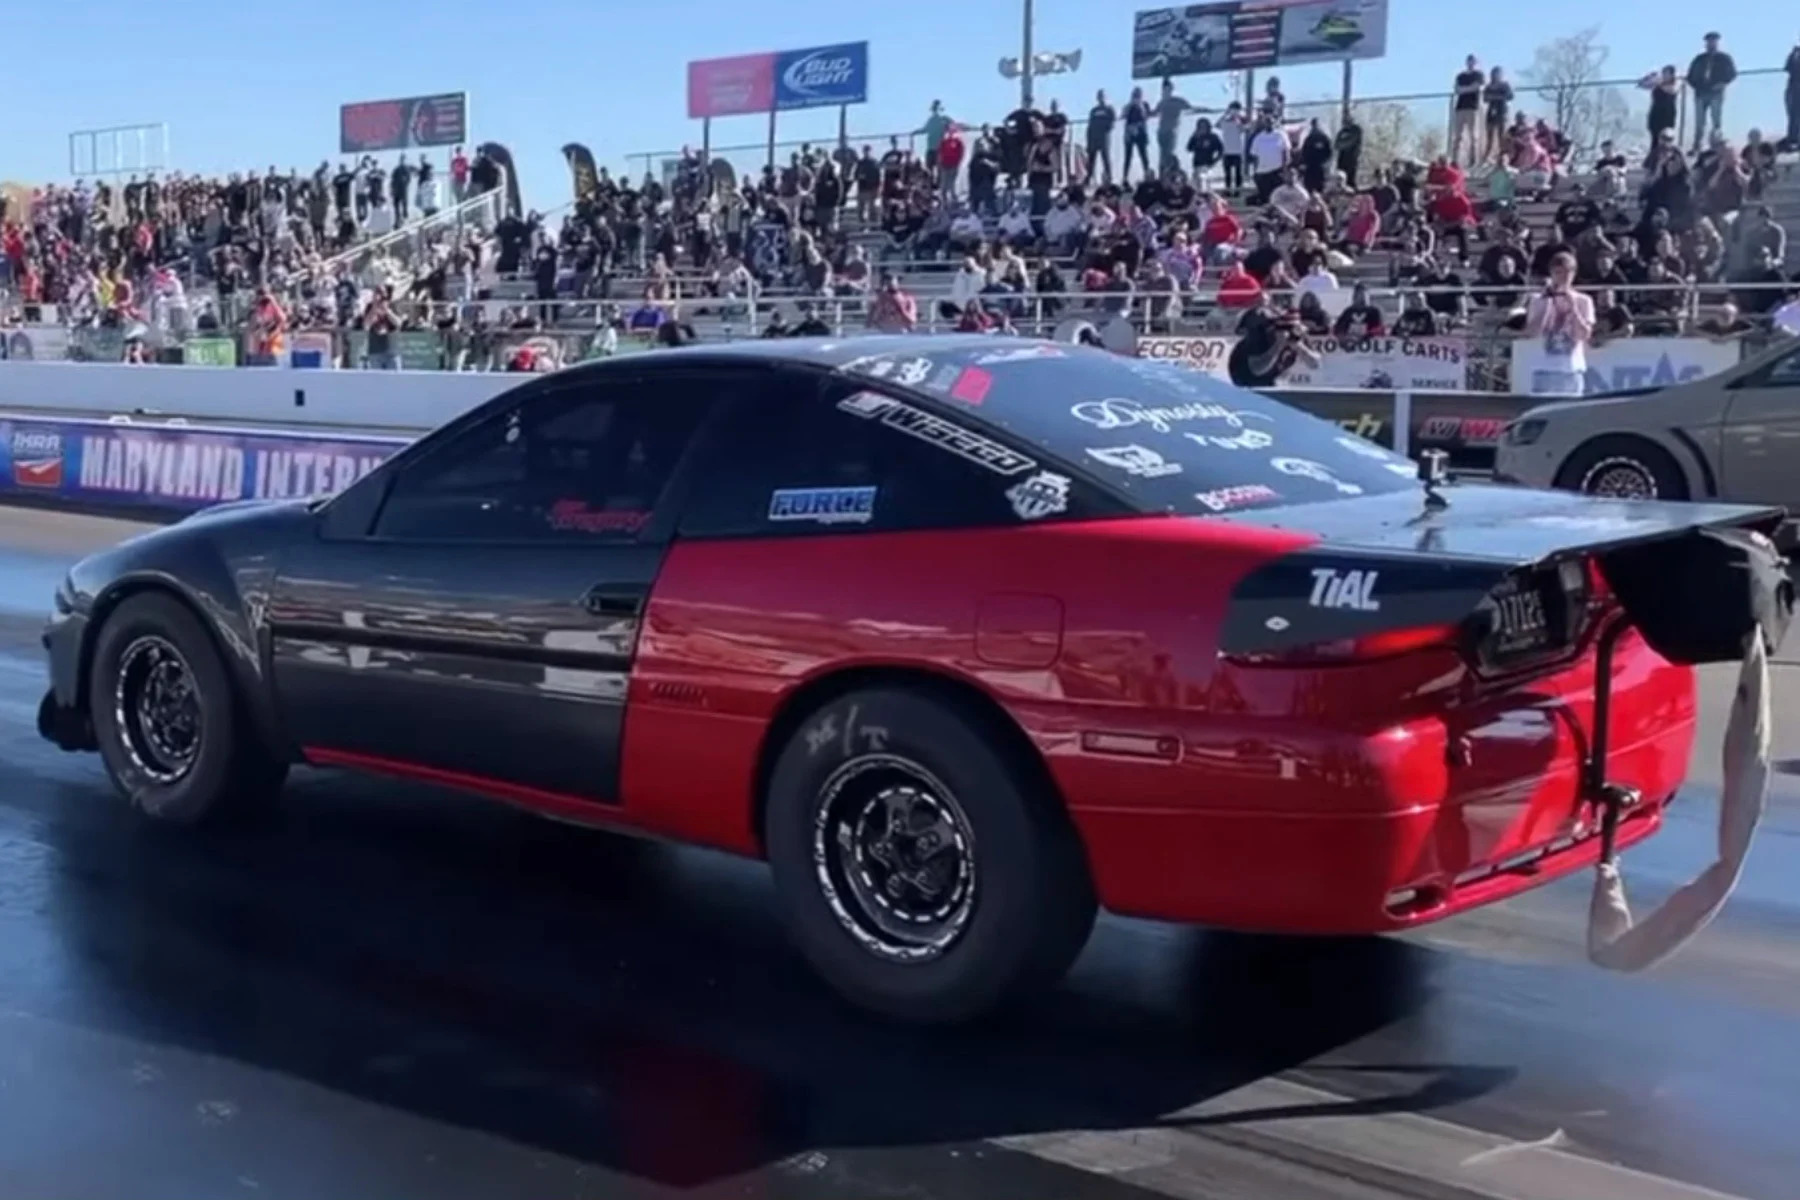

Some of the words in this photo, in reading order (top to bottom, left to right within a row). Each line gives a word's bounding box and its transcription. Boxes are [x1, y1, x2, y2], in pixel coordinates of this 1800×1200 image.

[804, 57, 852, 74] BUD
[797, 69, 854, 87] LIGHT
[1344, 338, 1396, 354] GOLF
[1402, 338, 1461, 365] CARTS
[13, 432, 60, 452] IHRA
[80, 435, 244, 499] MARYLAND
[253, 449, 385, 500] INTERN
